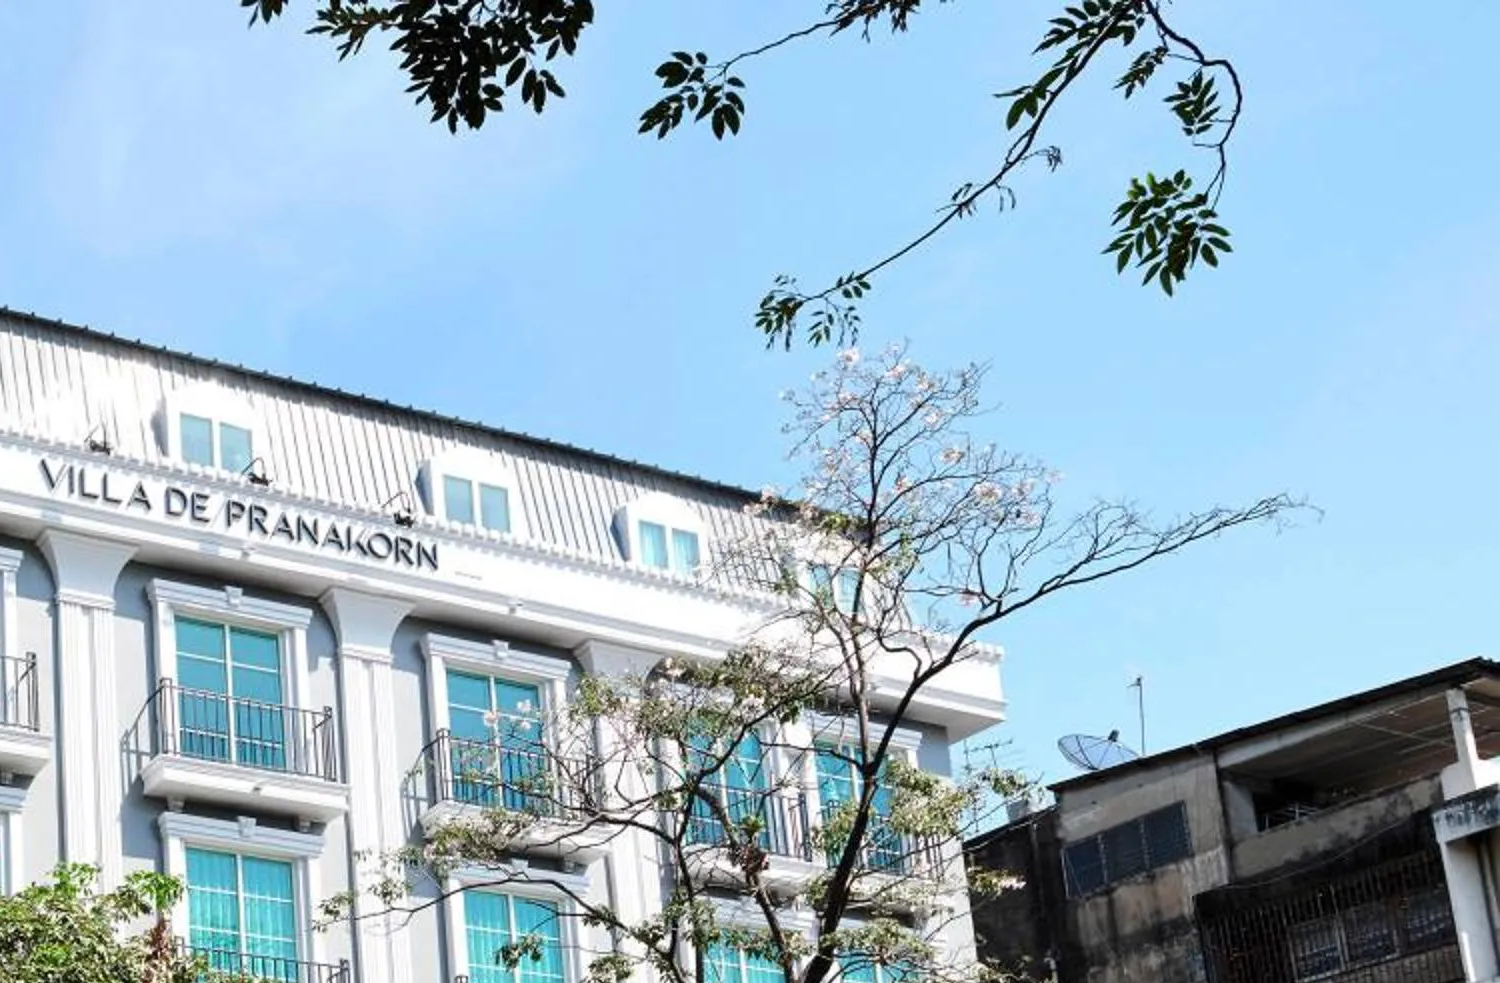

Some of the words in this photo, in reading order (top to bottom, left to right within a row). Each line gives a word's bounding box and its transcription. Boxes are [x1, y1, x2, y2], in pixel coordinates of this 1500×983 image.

[38, 458, 153, 511] VILLA
[165, 485, 211, 524] DE
[225, 498, 439, 571] PRANAKORN
